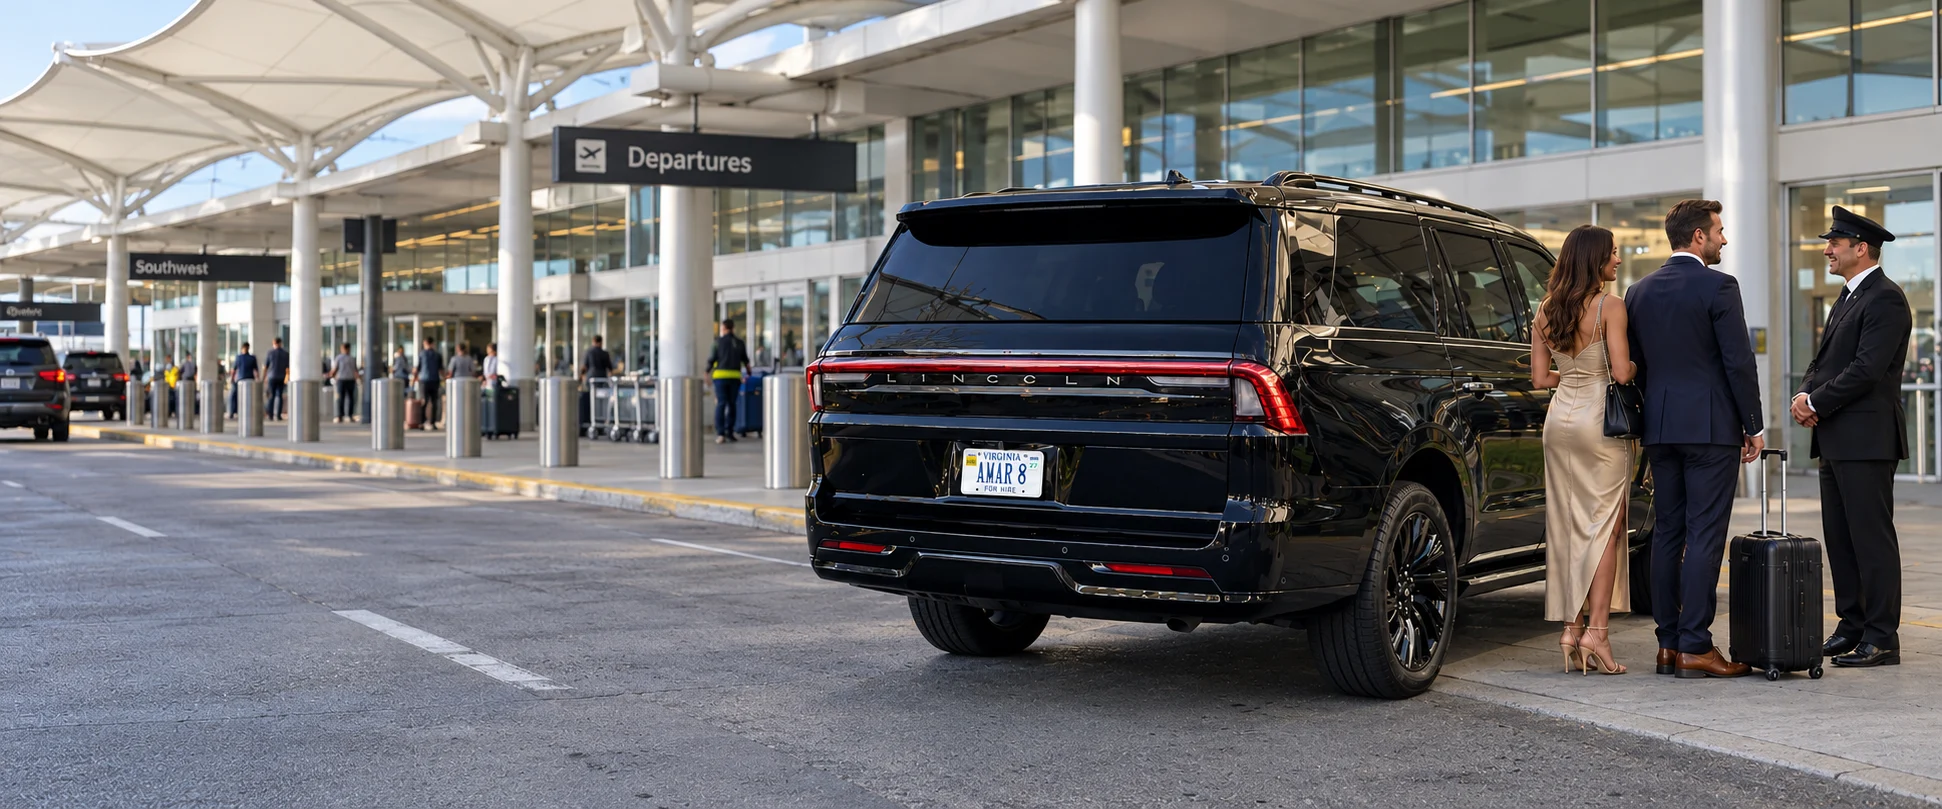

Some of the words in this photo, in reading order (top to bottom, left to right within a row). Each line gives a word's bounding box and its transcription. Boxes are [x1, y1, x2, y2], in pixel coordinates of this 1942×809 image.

[628, 146, 752, 174] Departures
[135, 259, 209, 275] Southwest
[983, 451, 1021, 461] VIRGINIA
[976, 461, 1013, 485] AMAR
[1018, 463, 1027, 485] 8
[984, 485, 998, 493] FOR
[1000, 486, 1017, 494] HIRE
